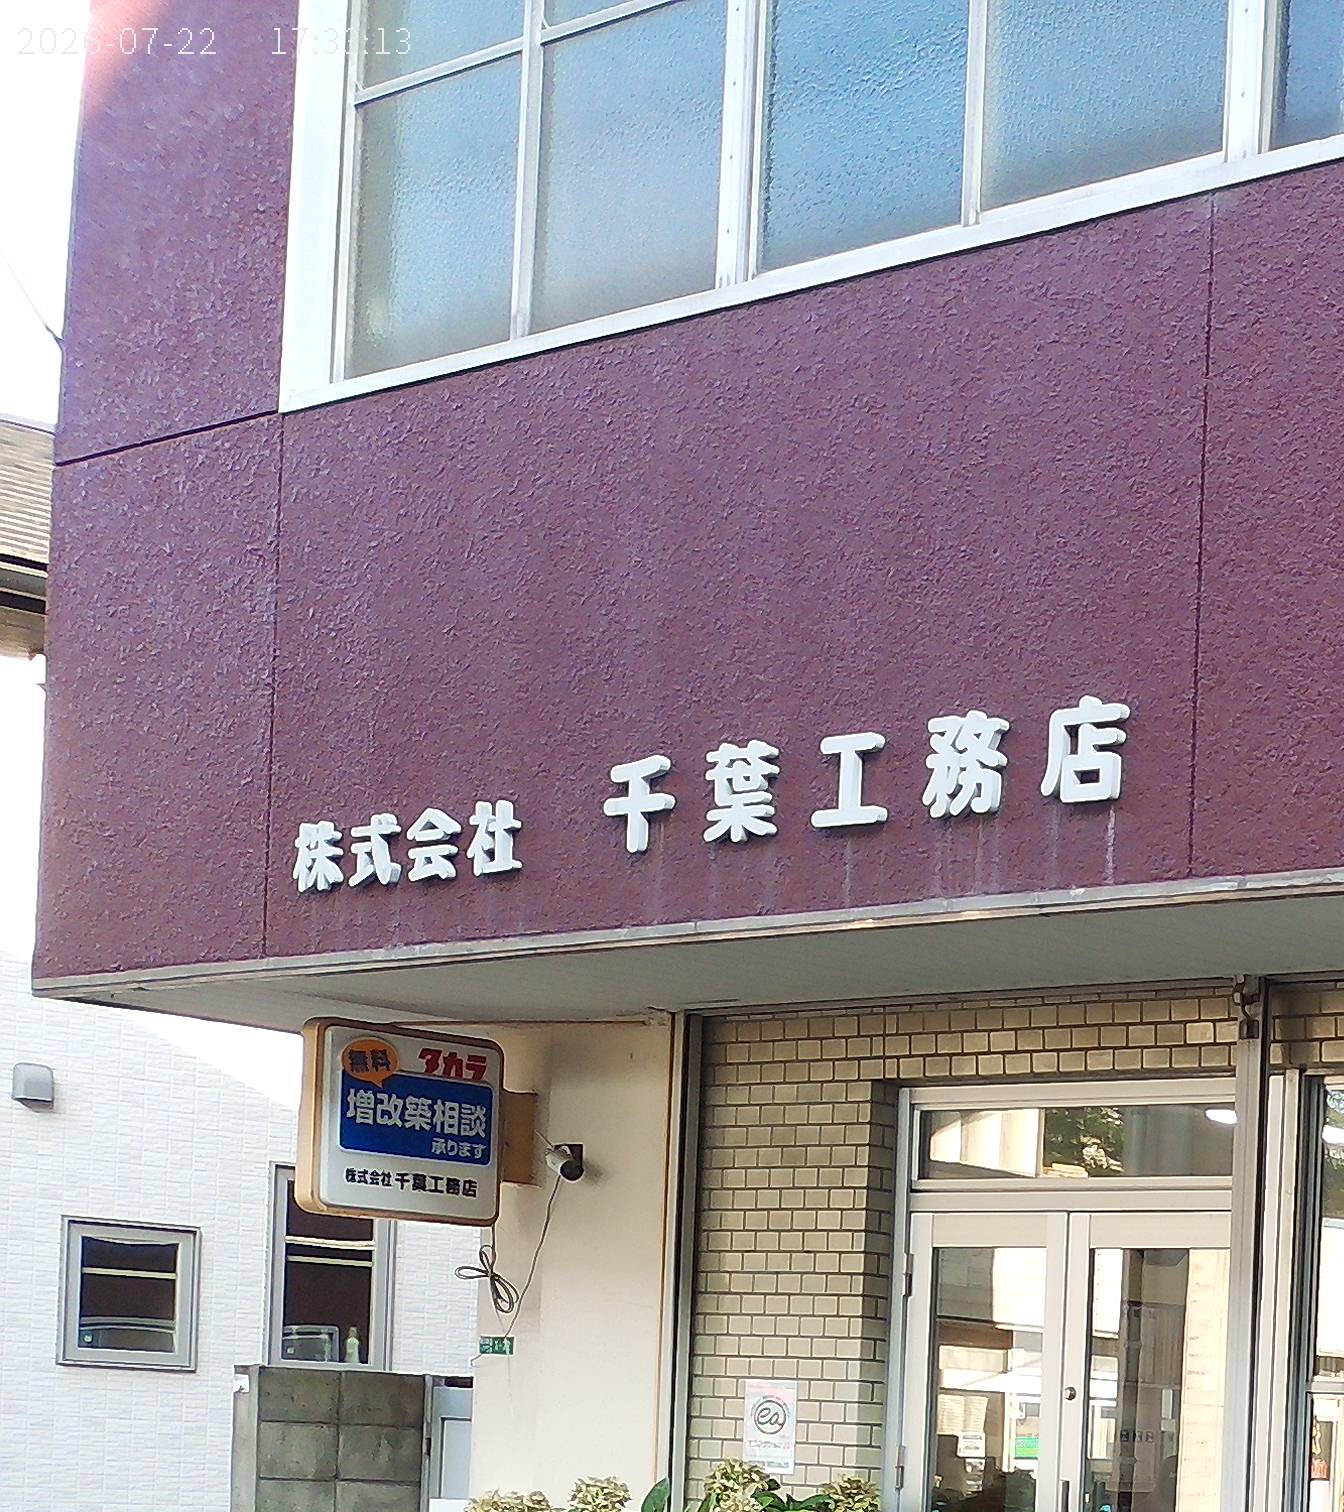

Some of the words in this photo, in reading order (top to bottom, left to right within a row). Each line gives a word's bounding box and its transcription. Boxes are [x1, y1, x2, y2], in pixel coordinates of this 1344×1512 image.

[291, 800, 524, 894] 株式会社
[602, 694, 1132, 854] 千葉工務店
[417, 1047, 488, 1081] タカラ
[346, 1087, 487, 1138] 増改築相談
[431, 1138, 487, 1160] 承ります
[345, 1167, 392, 1188] 株式会社
[394, 1172, 478, 1198] 千葉工務店
